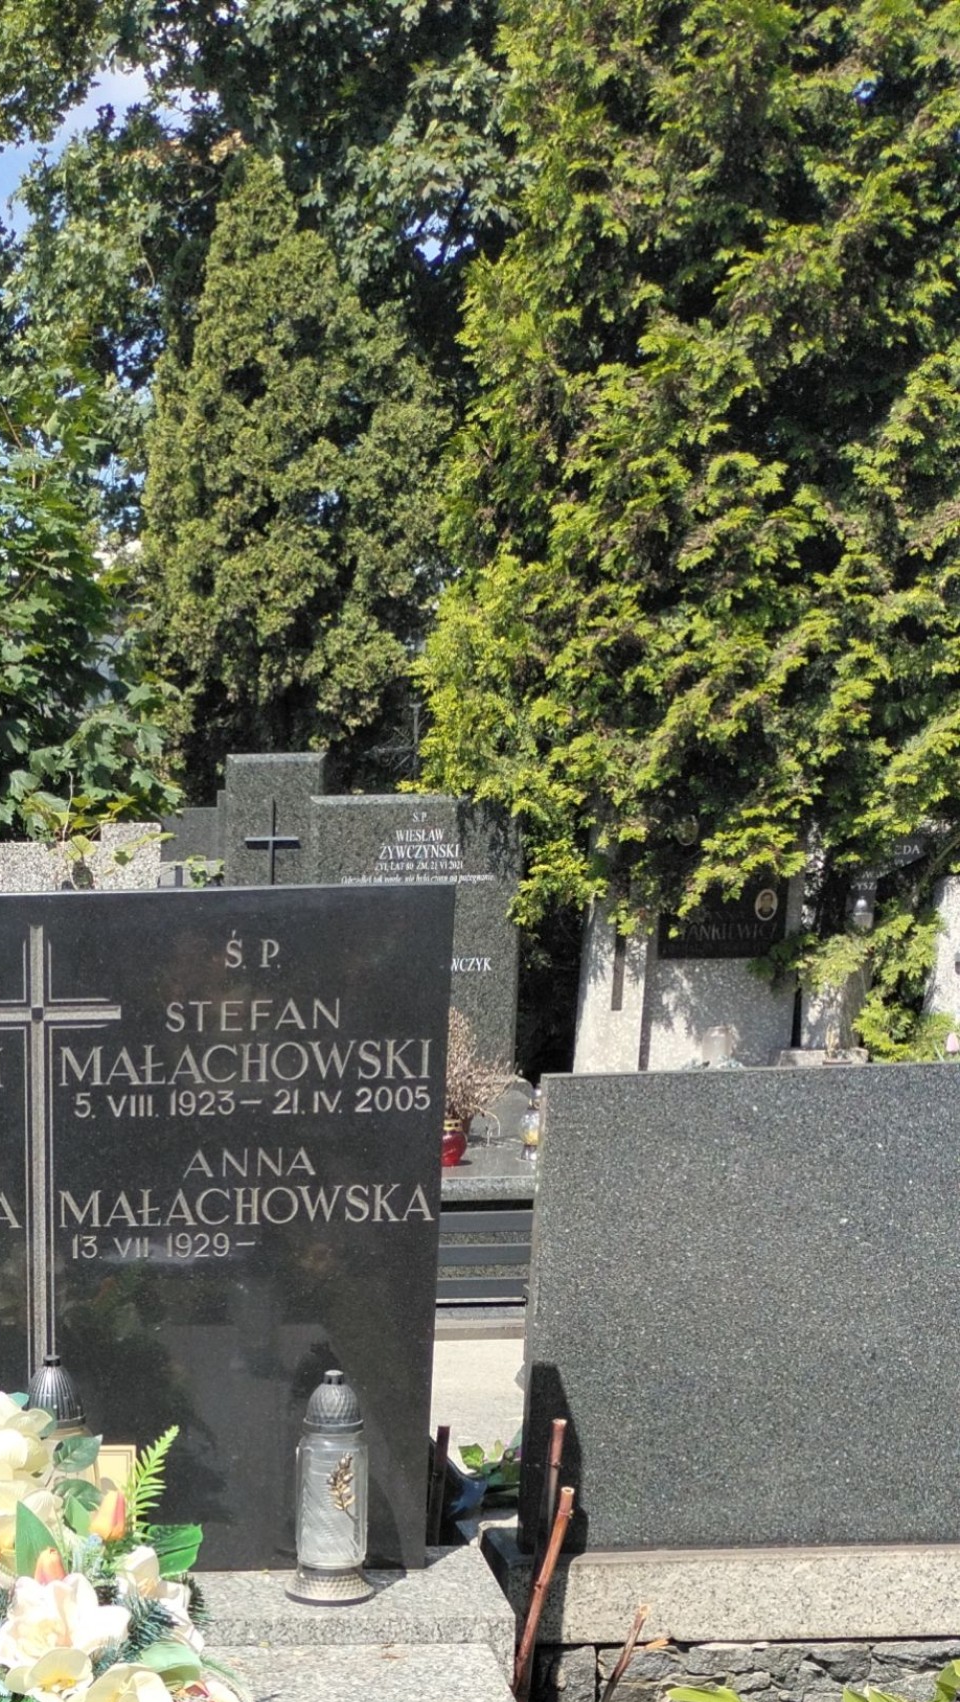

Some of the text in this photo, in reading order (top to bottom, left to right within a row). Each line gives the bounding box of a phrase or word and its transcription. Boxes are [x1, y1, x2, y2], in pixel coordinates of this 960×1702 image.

[165, 997, 340, 1032] STEFAN
[59, 1039, 433, 1086] MAŁACHOWSKI
[354, 1085, 431, 1113] 2005
[183, 1147, 316, 1178] ANNA
[58, 1183, 435, 1228] MAŁACHOWSKA
